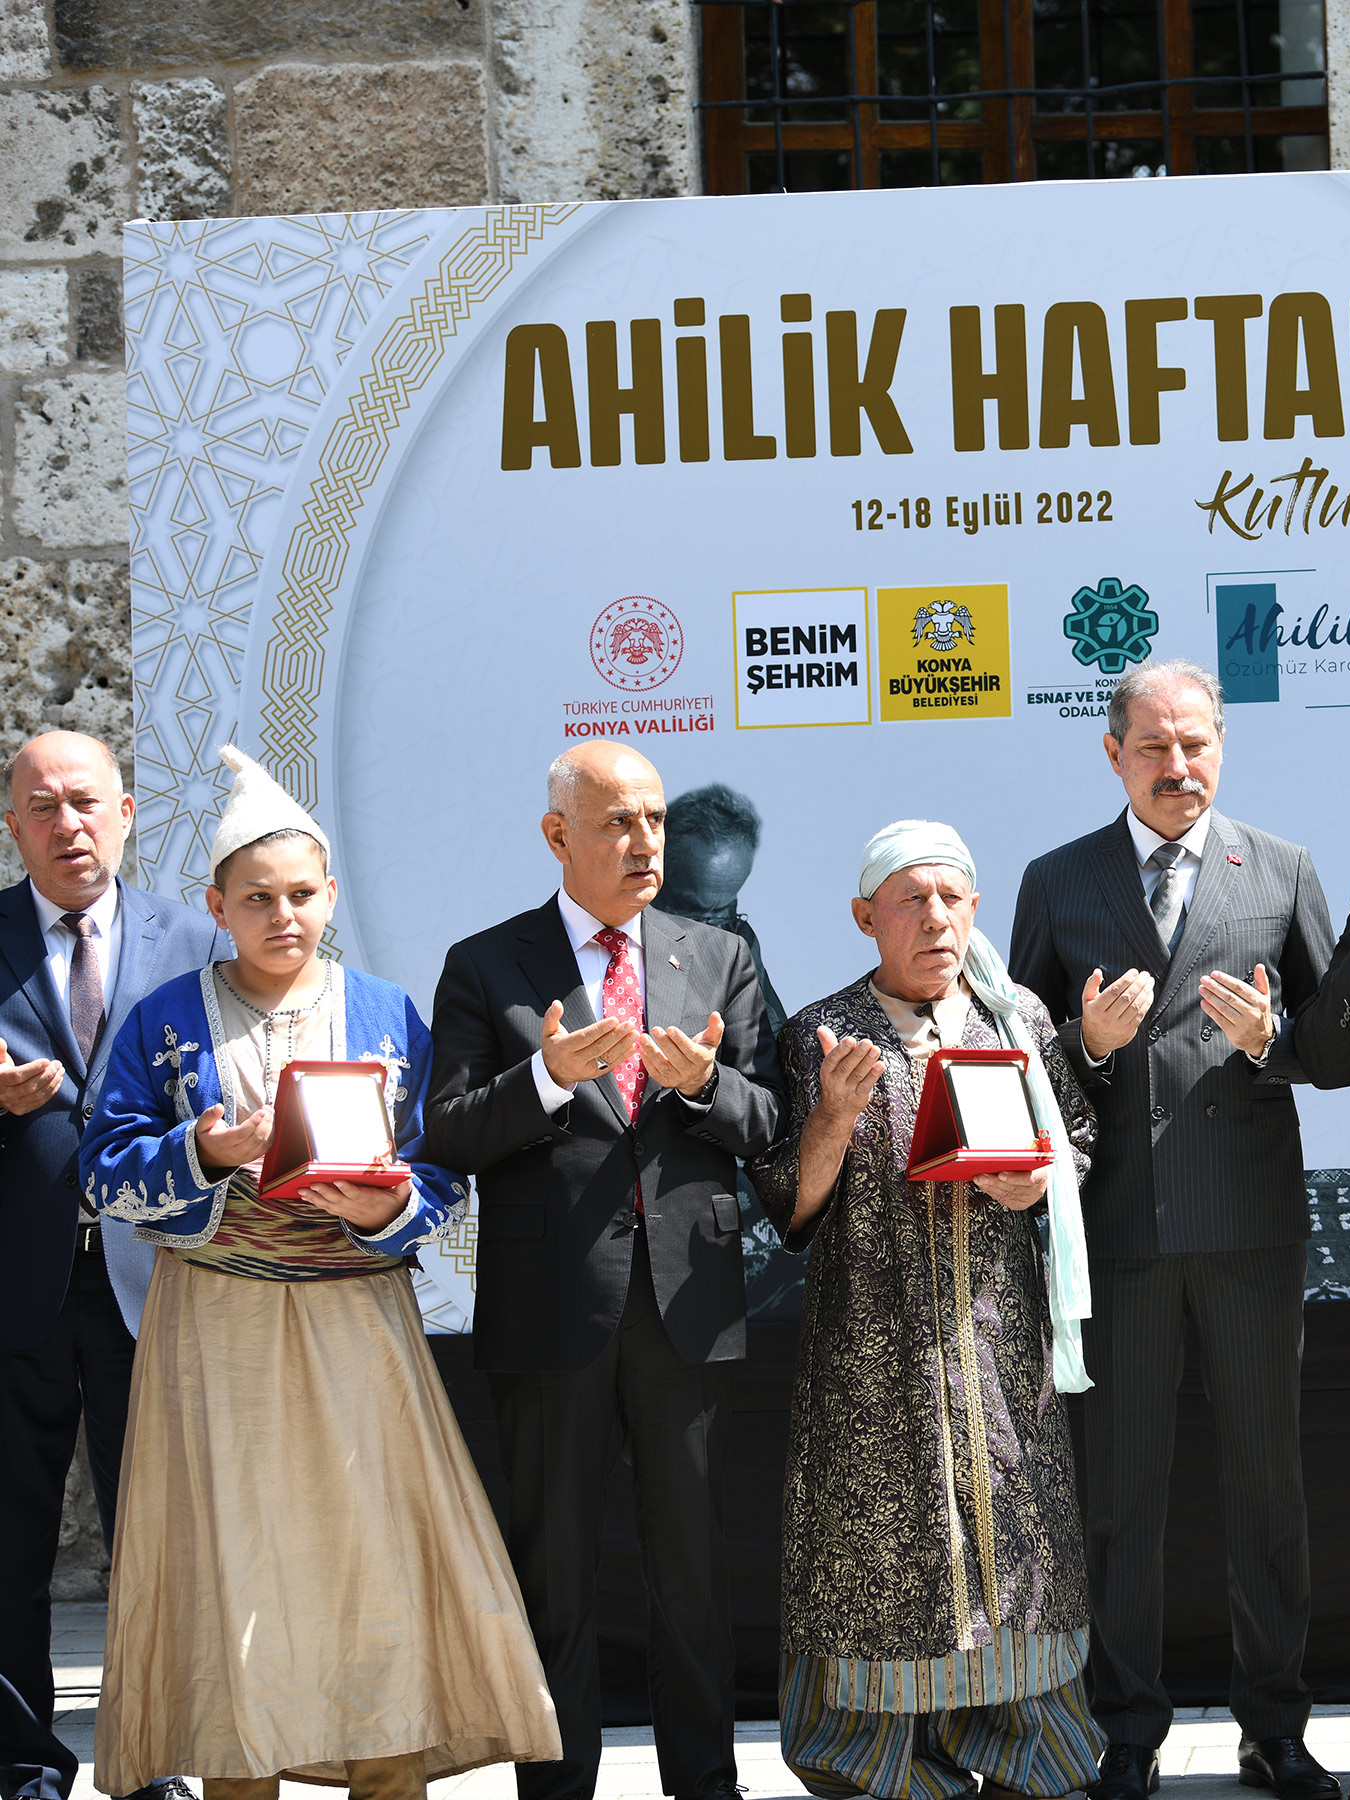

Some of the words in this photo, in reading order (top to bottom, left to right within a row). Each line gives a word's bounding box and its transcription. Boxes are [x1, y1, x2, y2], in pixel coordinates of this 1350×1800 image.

[851, 497, 932, 531] 12-18
[946, 492, 1023, 535] Eylül
[1036, 490, 1113, 524] 2022
[917, 658, 972, 673] KONYA
[1225, 659, 1308, 677] Özümüz
[889, 671, 1001, 695] BÜYÜKŞEHİR
[563, 700, 618, 715] TÜRKİYE
[621, 695, 714, 713] CUMHURİYETİ
[912, 695, 979, 708] BELEDİYESİ
[1027, 692, 1073, 704] ESNAF
[1075, 691, 1094, 702] VE
[1059, 705, 1109, 718] ODALA
[564, 721, 630, 737] KONYA
[634, 713, 715, 734] VALİLİĞİ
